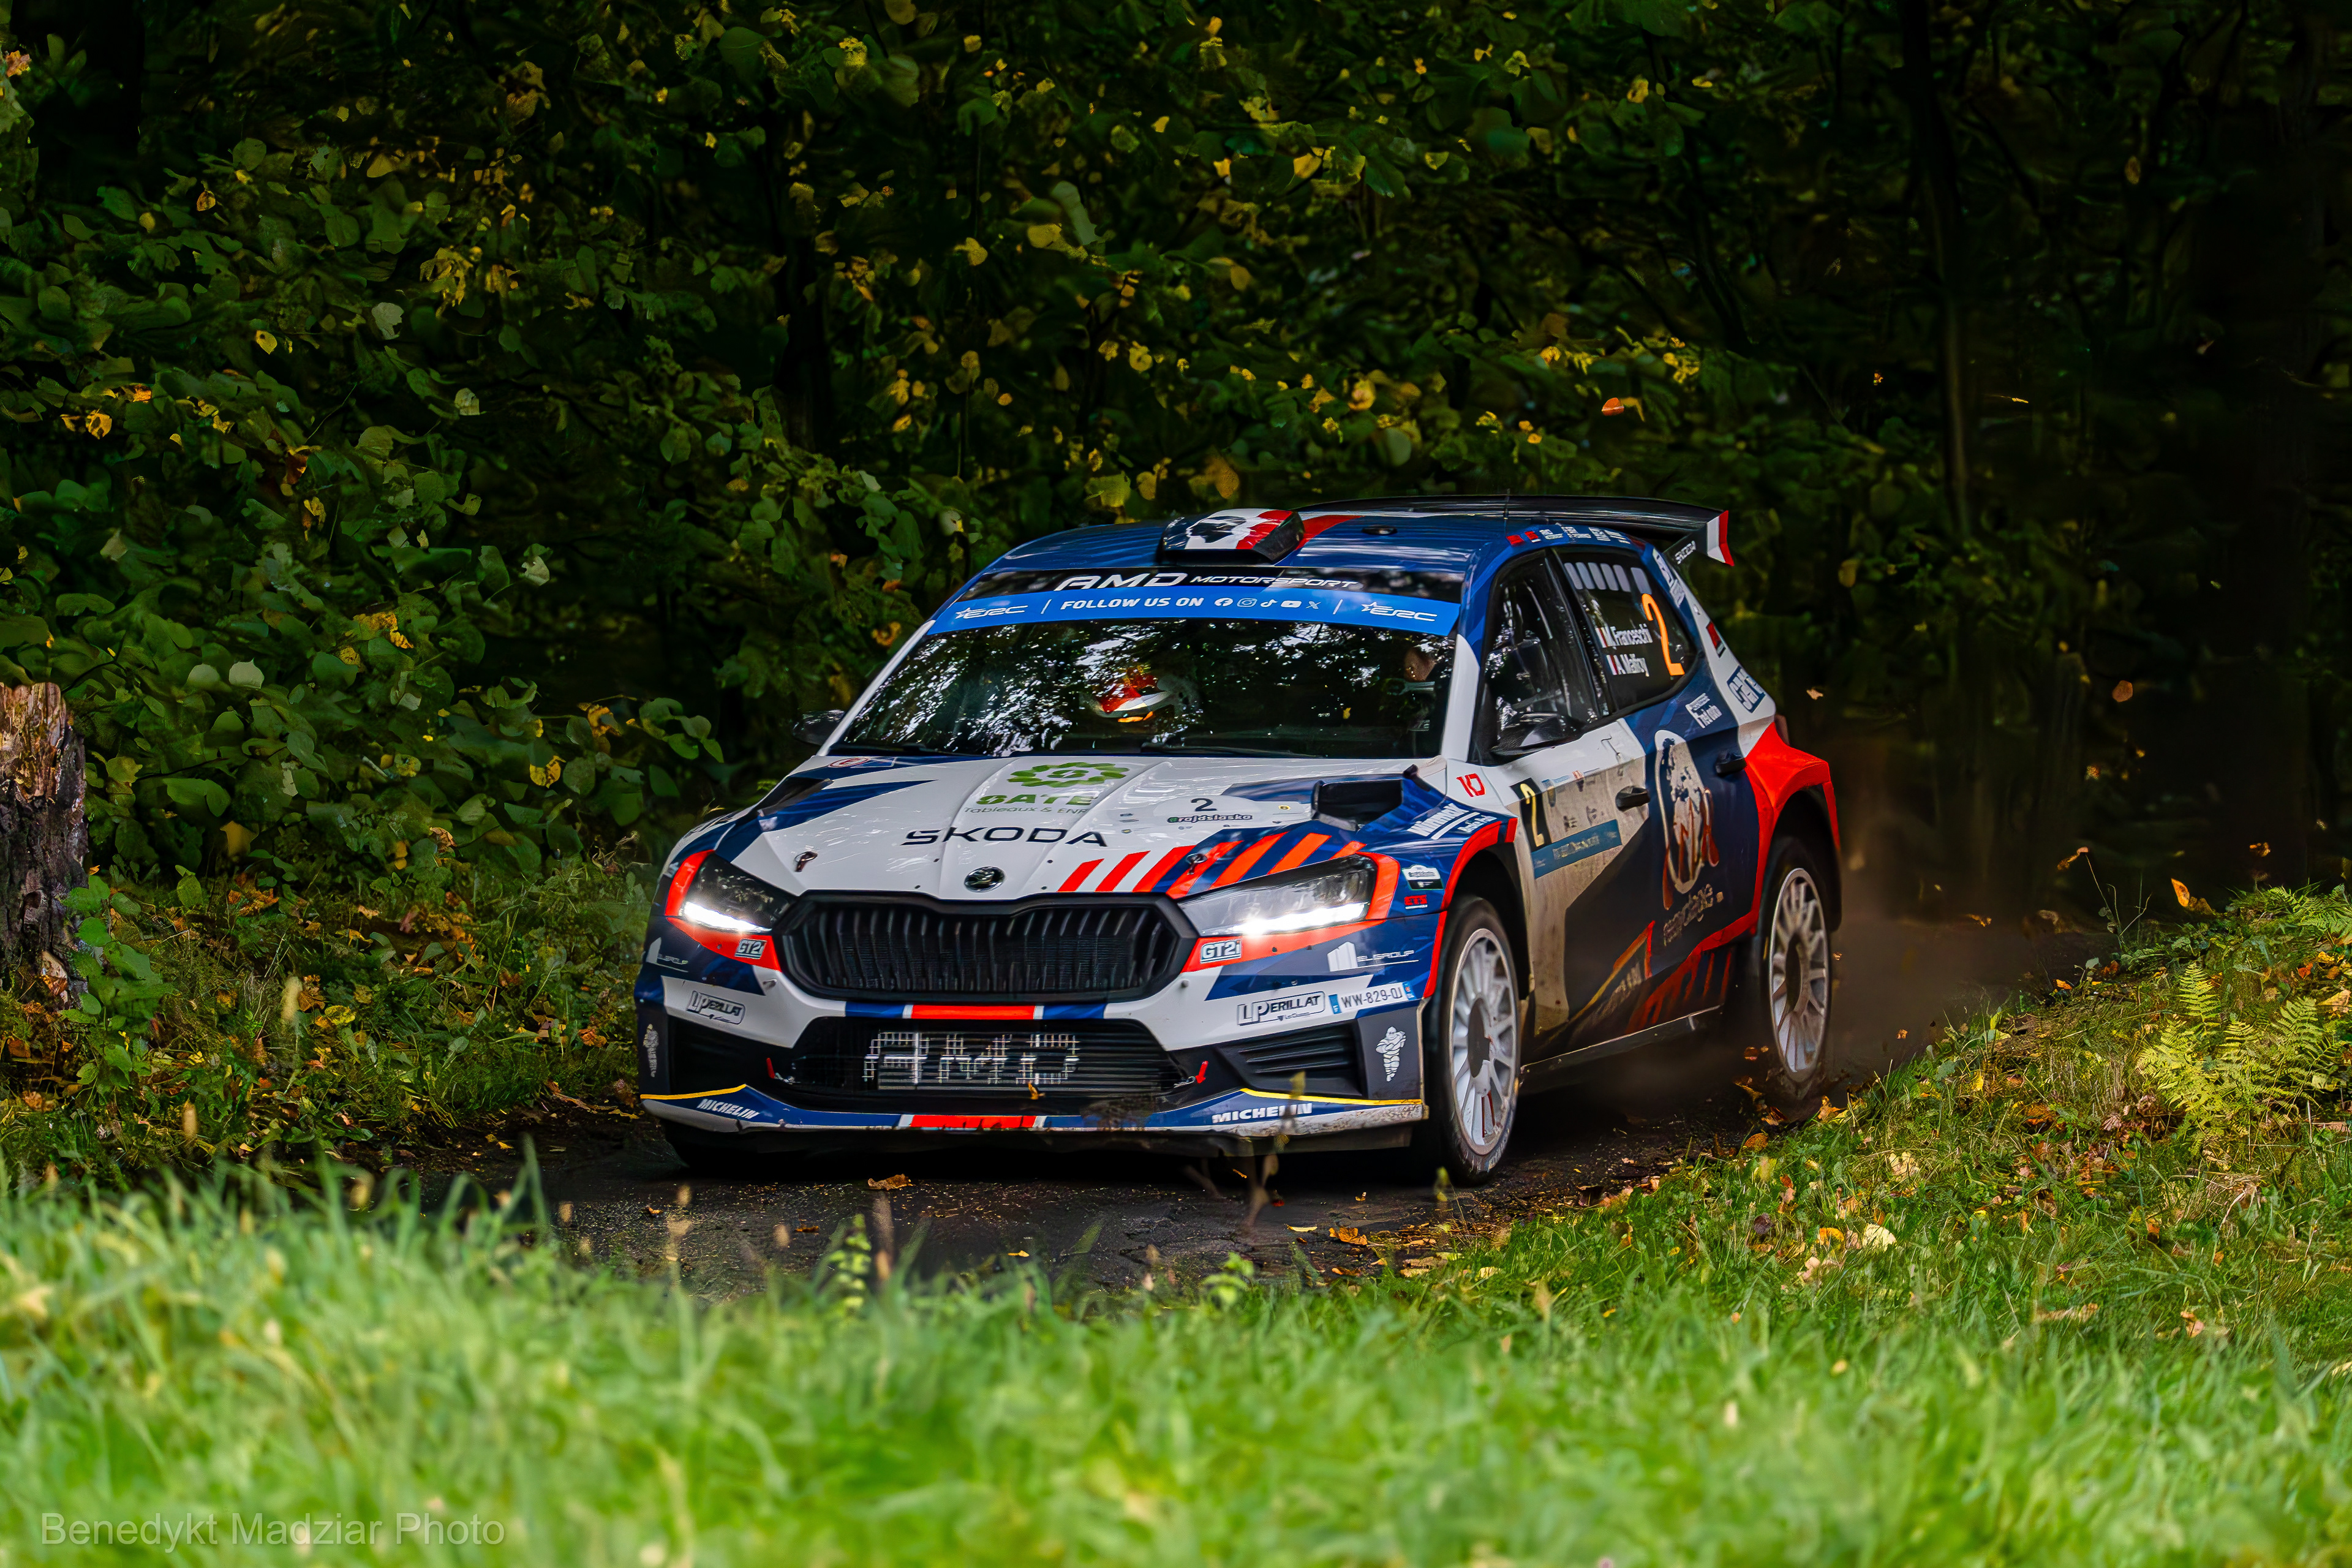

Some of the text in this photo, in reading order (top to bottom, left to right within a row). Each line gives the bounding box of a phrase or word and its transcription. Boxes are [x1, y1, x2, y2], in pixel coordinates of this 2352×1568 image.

[1054, 573, 1358, 592] AMD MOTORSPORT
[1060, 597, 1204, 610] FOLLOW US ON
[1642, 594, 1685, 676] 2
[976, 794, 1094, 806] SATE
[1191, 798, 1217, 812] 2
[1520, 783, 1545, 847] 2
[1202, 940, 1241, 959] GT2i
[696, 1098, 760, 1120] MICHELIN
